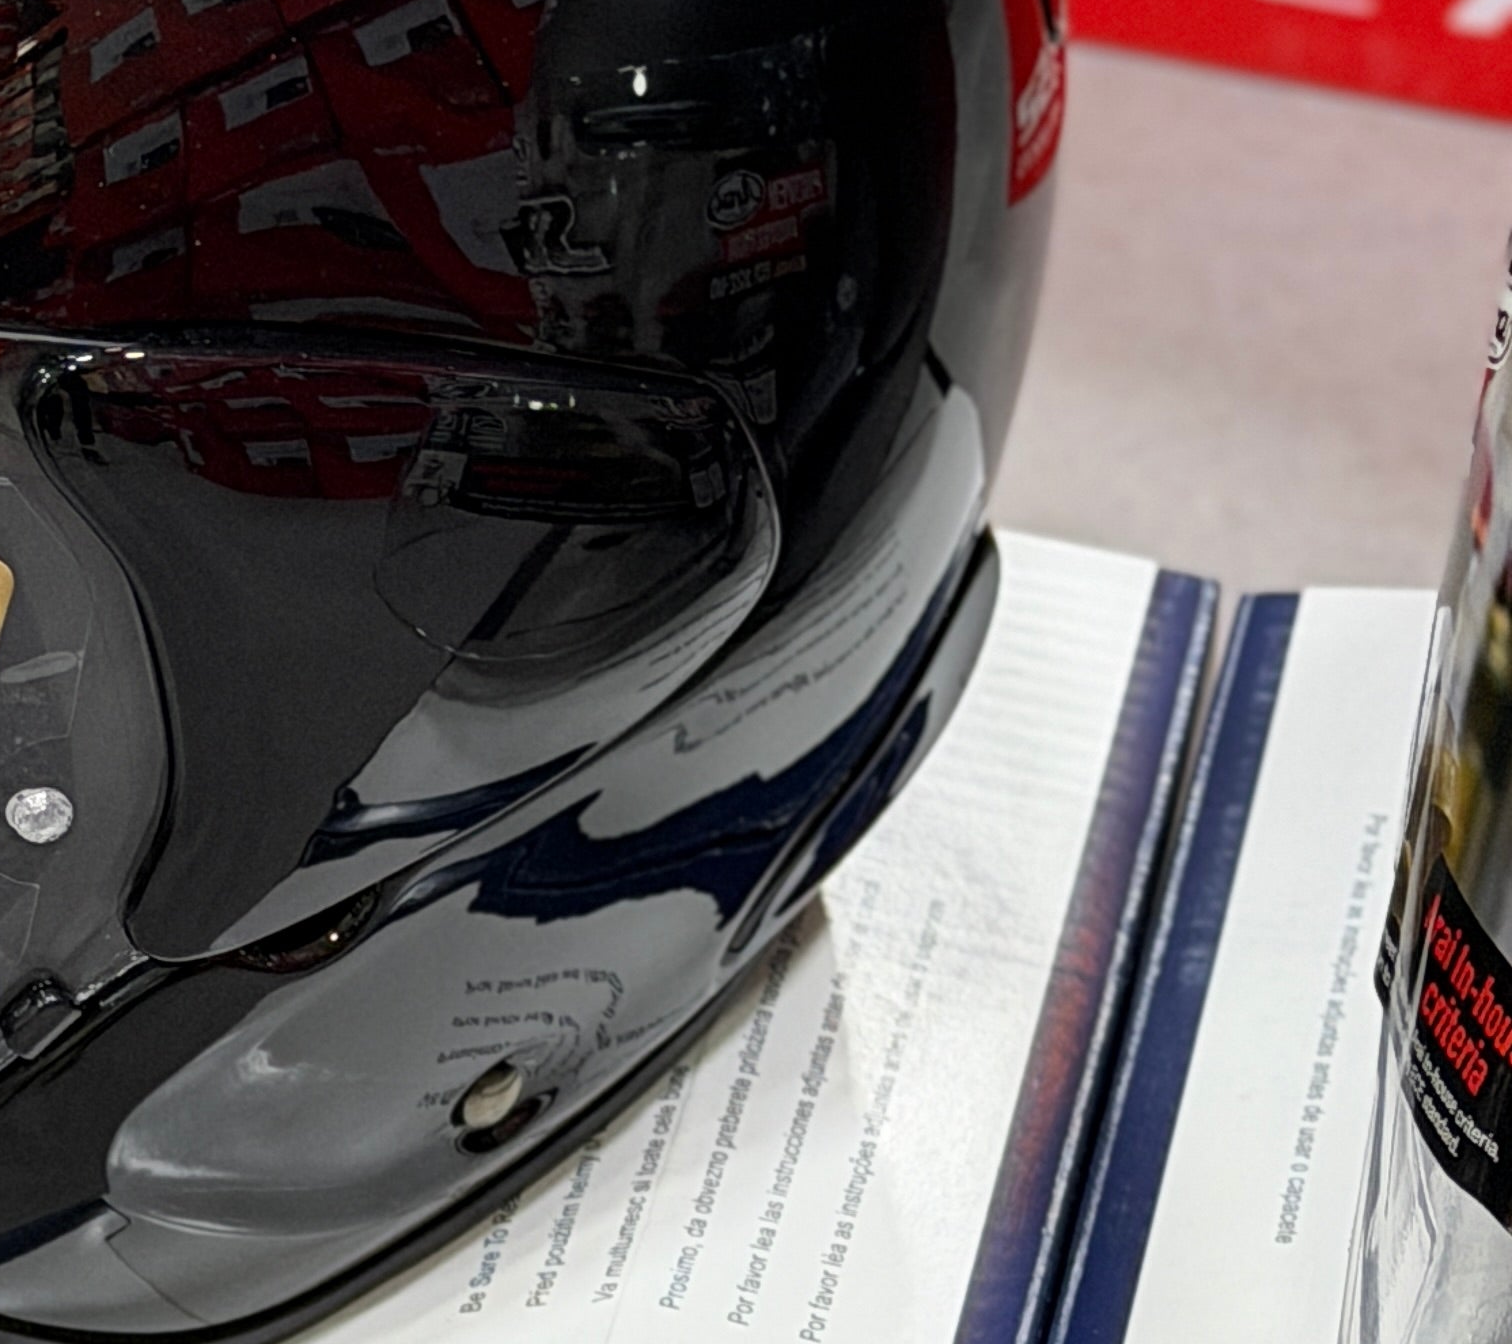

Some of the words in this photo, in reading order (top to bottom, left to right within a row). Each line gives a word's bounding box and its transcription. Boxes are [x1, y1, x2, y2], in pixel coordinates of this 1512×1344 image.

[821, 993, 846, 1032] antes
[1422, 982, 1488, 1096] criteria
[801, 1035, 835, 1096] adjuntas
[1307, 1061, 1330, 1100] antes
[715, 1076, 752, 1149] preberete
[1302, 1105, 1325, 1122] de
[766, 1099, 815, 1198] instrucciones
[1294, 1127, 1316, 1159] usar
[691, 1151, 729, 1214] obvezno
[835, 1140, 877, 1218] instruções
[1291, 1163, 1309, 1173] o
[683, 1218, 707, 1239] da
[758, 1200, 784, 1224] las
[1275, 1177, 1305, 1244] capacete
[484, 1228, 509, 1248] To
[750, 1227, 777, 1251] lea
[834, 1220, 854, 1240] as
[469, 1251, 501, 1288] Sure
[659, 1244, 704, 1310] Prosimo,
[737, 1254, 768, 1294] favor
[459, 1291, 486, 1313] Be
[808, 1269, 840, 1311] favor
[727, 1297, 756, 1327] Por
[799, 1313, 827, 1344] Por
